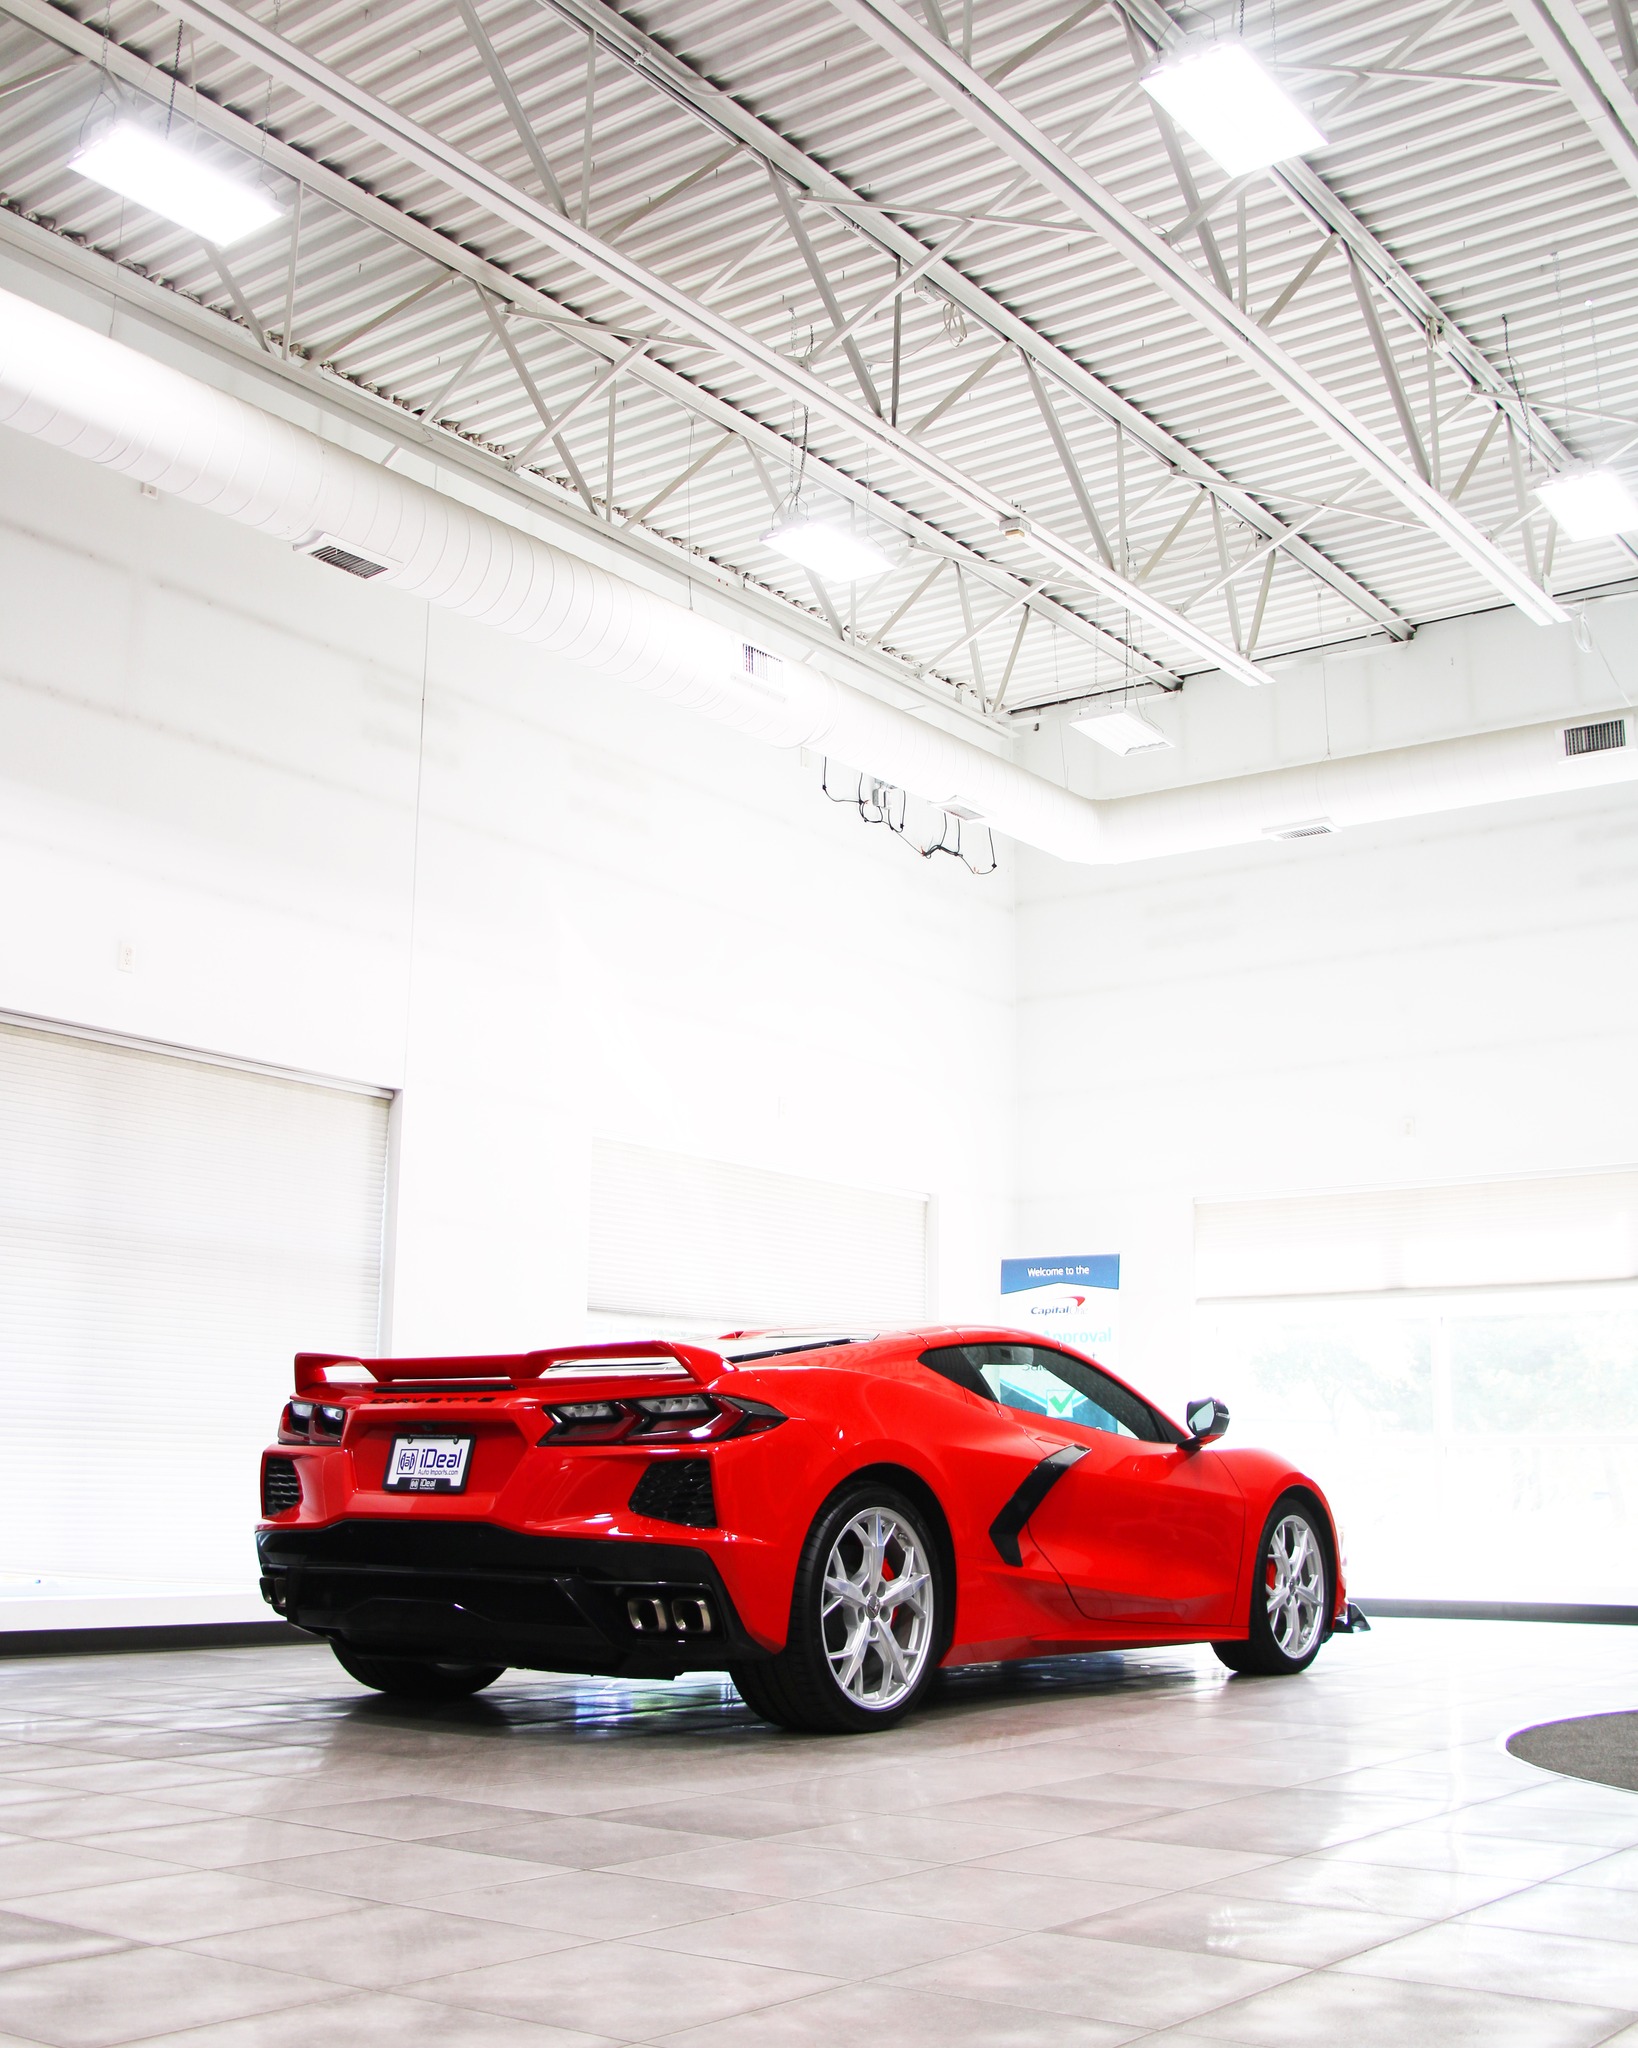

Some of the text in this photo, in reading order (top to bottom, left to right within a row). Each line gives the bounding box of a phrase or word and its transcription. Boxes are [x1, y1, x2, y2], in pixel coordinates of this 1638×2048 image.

[1027, 1265, 1090, 1277] Welcome to the
[419, 1448, 463, 1468] iDeal
